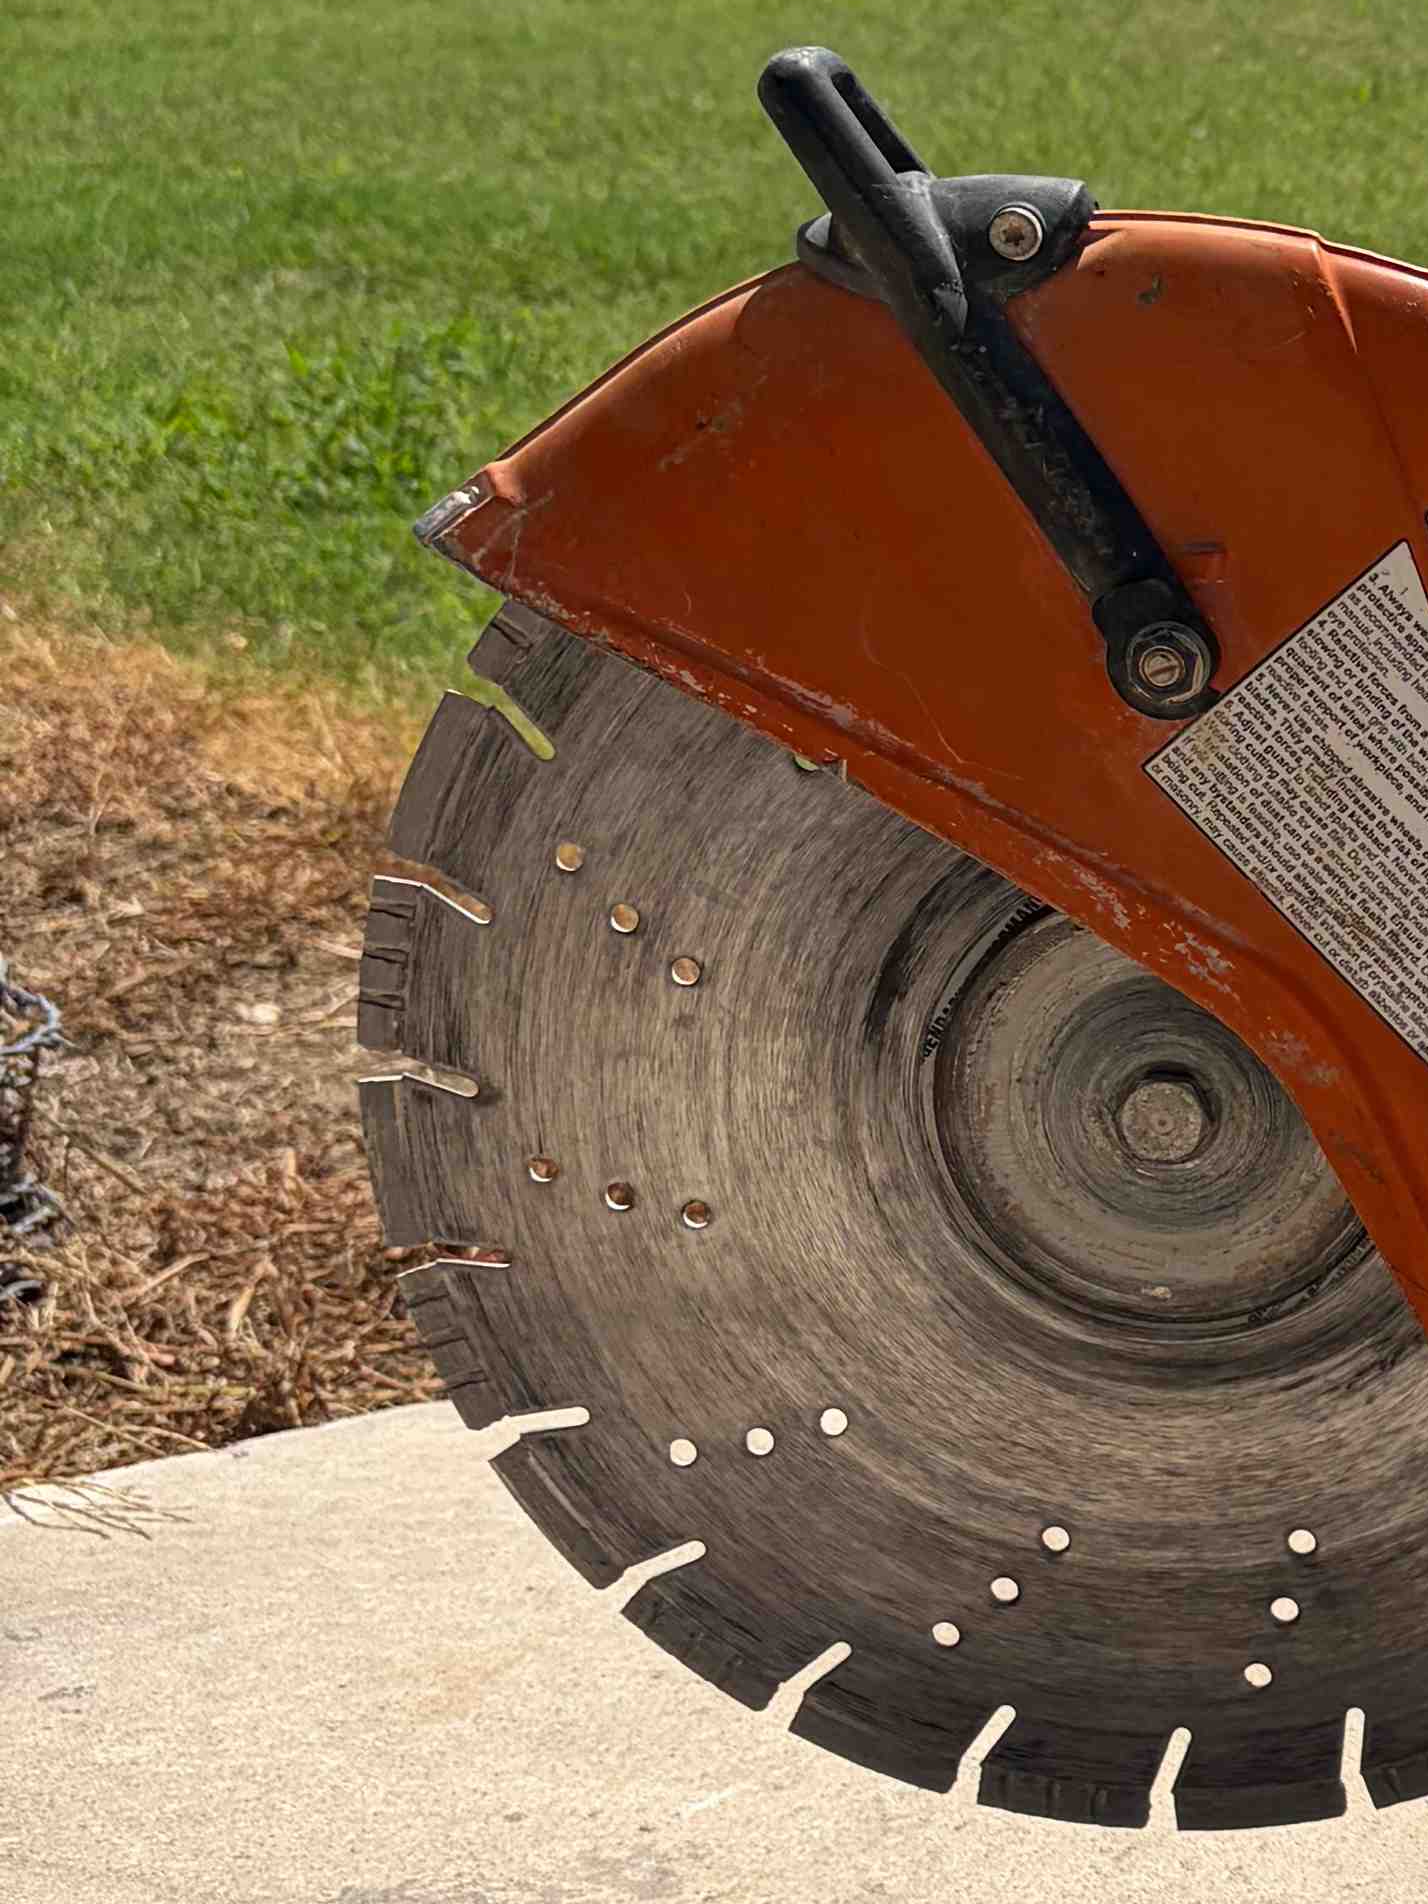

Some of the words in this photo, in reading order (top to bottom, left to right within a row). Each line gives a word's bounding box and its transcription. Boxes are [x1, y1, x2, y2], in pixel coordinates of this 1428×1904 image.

[1356, 583, 1405, 633] protective
[1377, 584, 1413, 622] Always
[1306, 628, 1345, 669] slowing
[1343, 667, 1357, 679] or
[1354, 678, 1392, 719] binding
[1390, 718, 1405, 730] of
[1401, 728, 1419, 748] the
[1327, 628, 1368, 673] Reactive
[1367, 671, 1398, 706] forces
[1397, 703, 1421, 731] from
[1419, 729, 1428, 739] a
[1264, 682, 1295, 714] Never
[1293, 713, 1312, 734] use
[1389, 815, 1422, 851] wheels
[1279, 716, 1304, 744] They
[1335, 777, 1376, 821] increase
[1375, 819, 1392, 838] the
[1391, 837, 1411, 858] risk
[1410, 857, 1425, 869] of
